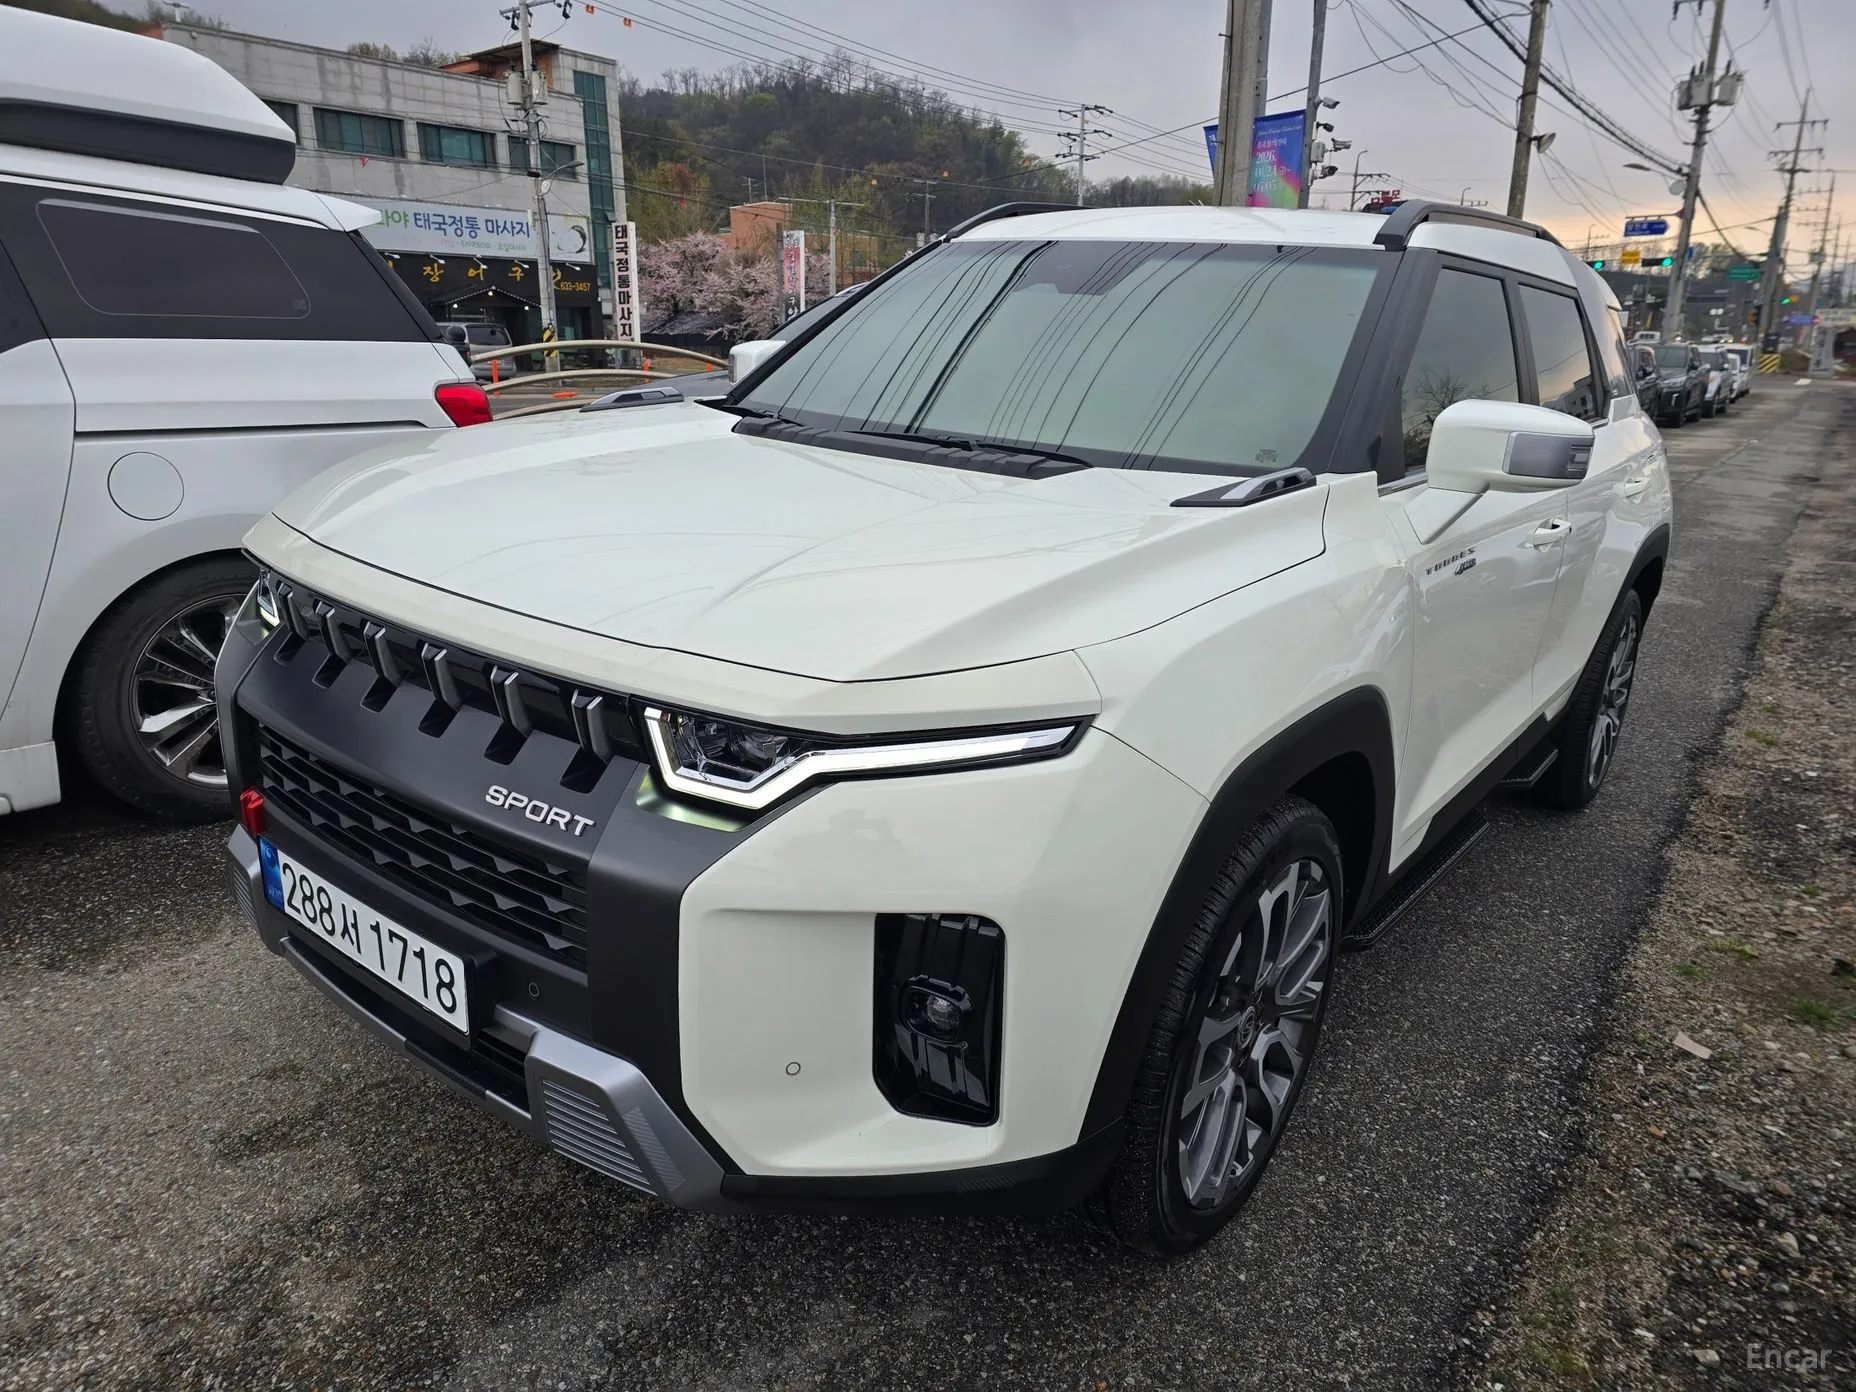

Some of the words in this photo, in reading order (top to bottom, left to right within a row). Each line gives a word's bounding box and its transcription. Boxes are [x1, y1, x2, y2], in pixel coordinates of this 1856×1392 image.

[413, 211, 480, 239] 태국정통
[485, 219, 530, 238] 마사지
[560, 281, 591, 293] 633-3457
[614, 224, 632, 337] 태국정통마사지
[485, 785, 595, 836] SPORT
[282, 862, 361, 954] 288서
[370, 920, 457, 1014] 1718
